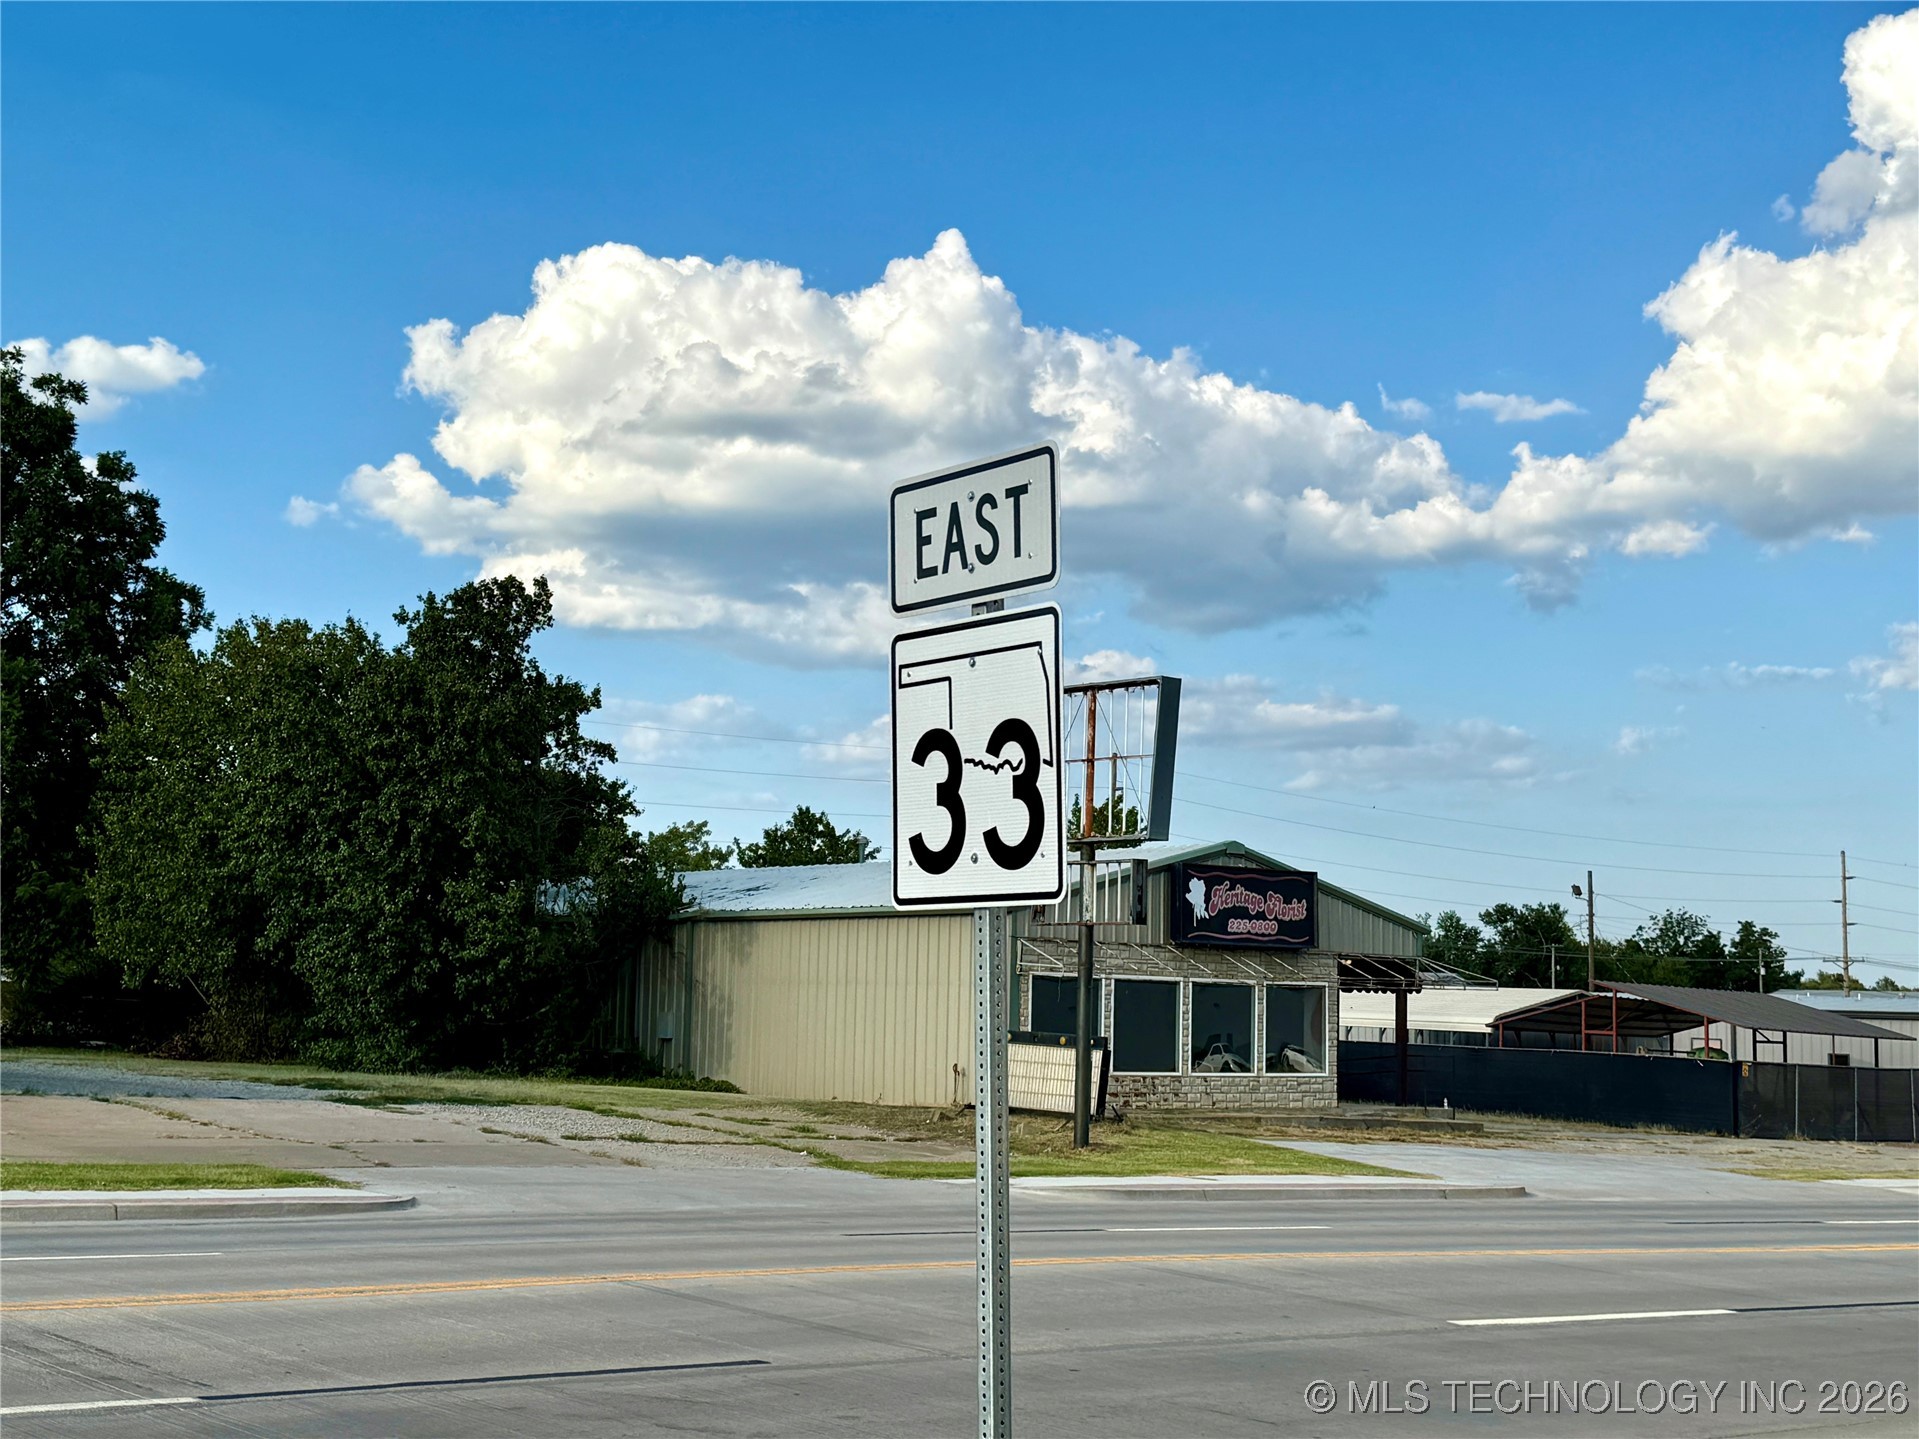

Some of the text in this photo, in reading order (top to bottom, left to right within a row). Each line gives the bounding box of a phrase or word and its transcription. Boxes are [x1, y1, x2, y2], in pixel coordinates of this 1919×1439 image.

[916, 484, 1029, 580] EAST
[908, 718, 1045, 875] 33
[1209, 881, 1307, 920] Heritage Florist
